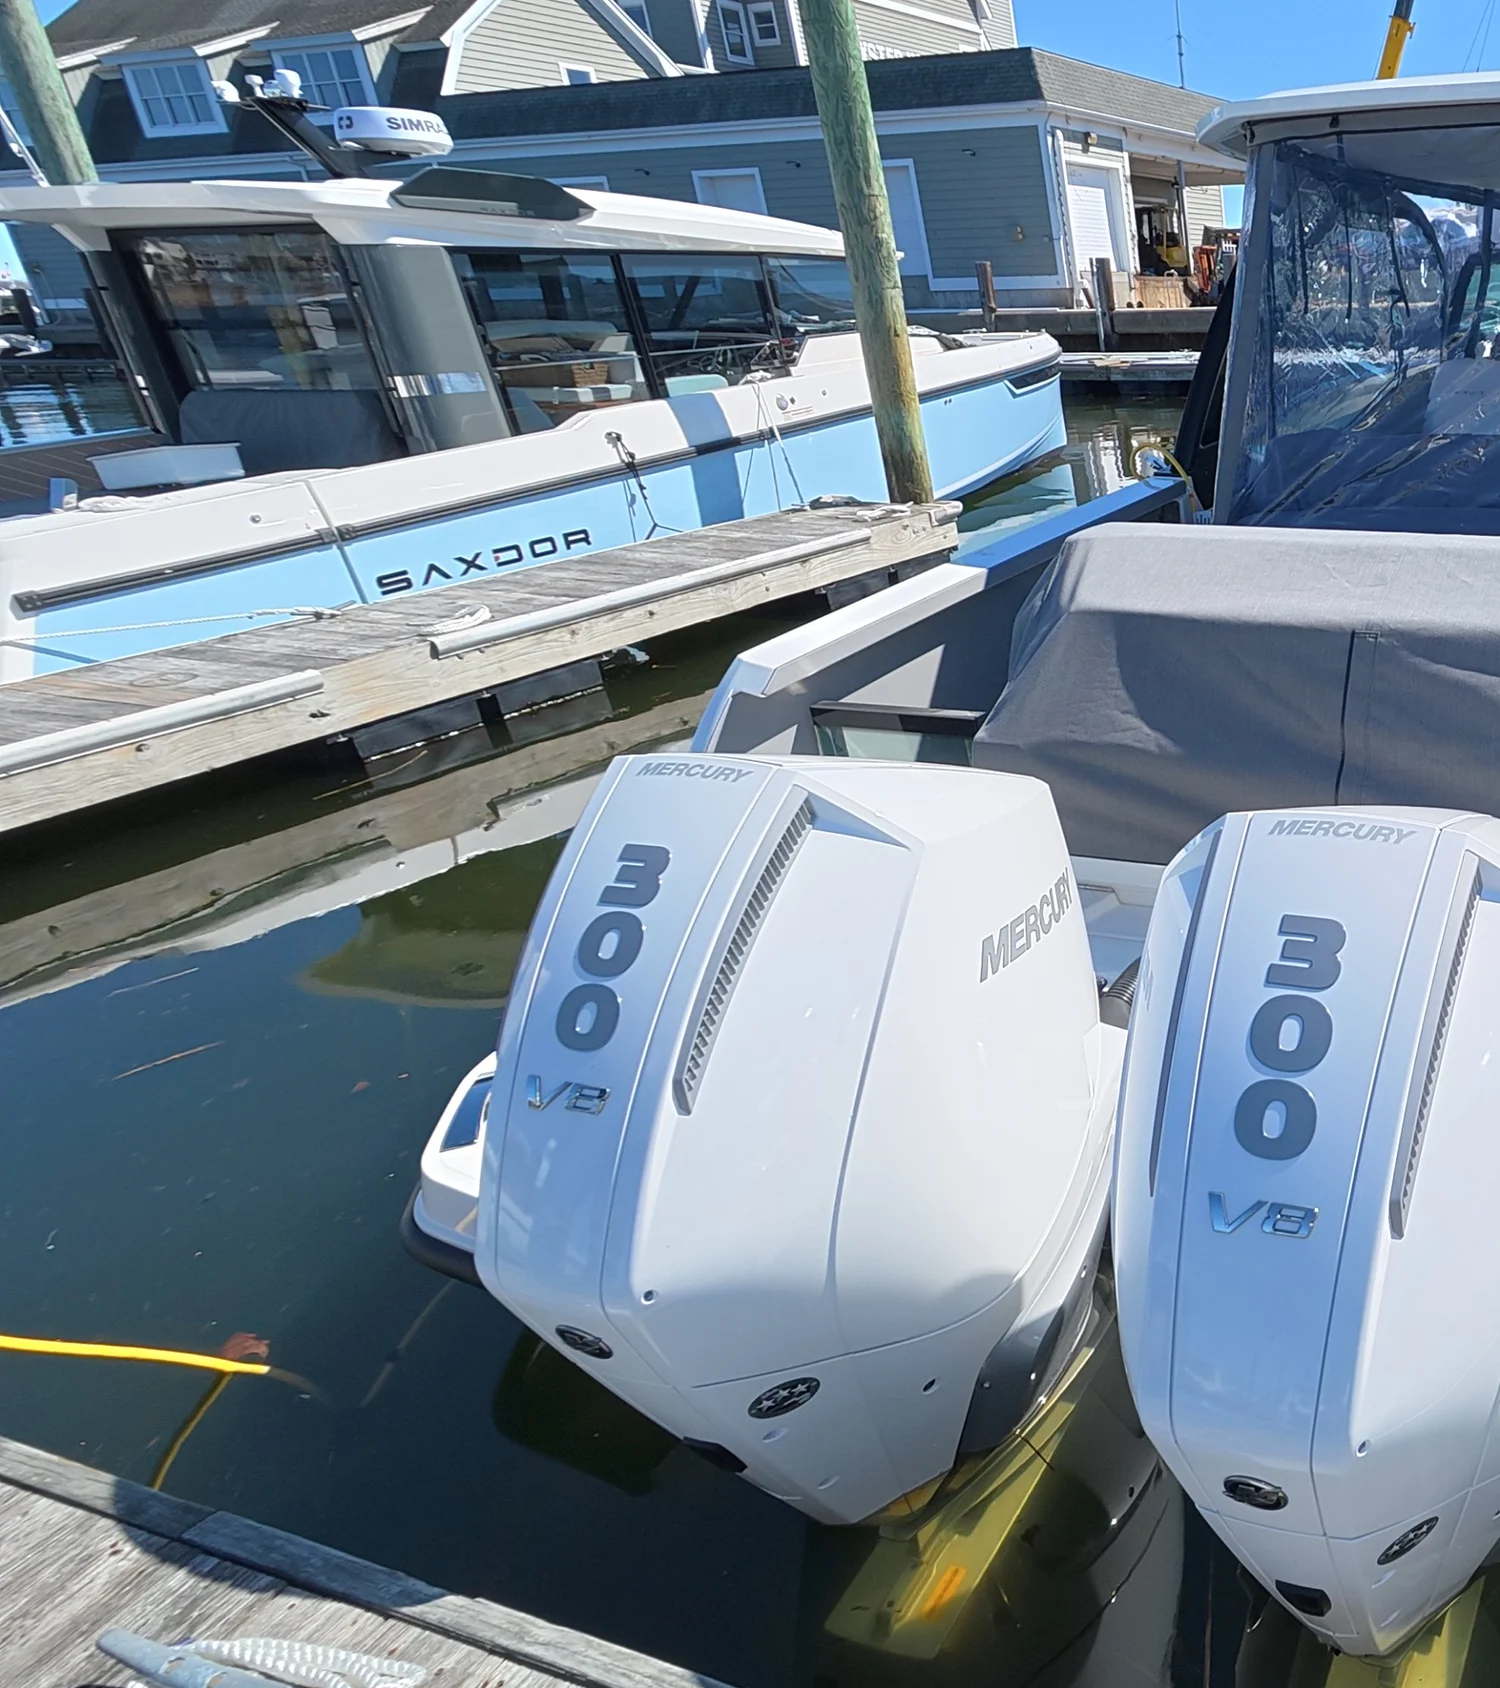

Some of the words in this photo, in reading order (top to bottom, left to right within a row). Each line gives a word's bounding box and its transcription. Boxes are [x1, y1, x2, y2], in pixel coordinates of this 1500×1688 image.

[385, 116, 449, 135] SIMRA
[376, 529, 592, 595] SAXDOR
[635, 762, 755, 783] MERCURY
[1267, 819, 1418, 845] MERCURY
[556, 843, 672, 1052] 300
[979, 866, 1072, 983] MERCURY
[1233, 913, 1347, 1161] 300
[526, 1074, 611, 1116] V8
[1208, 1191, 1319, 1239] V8
